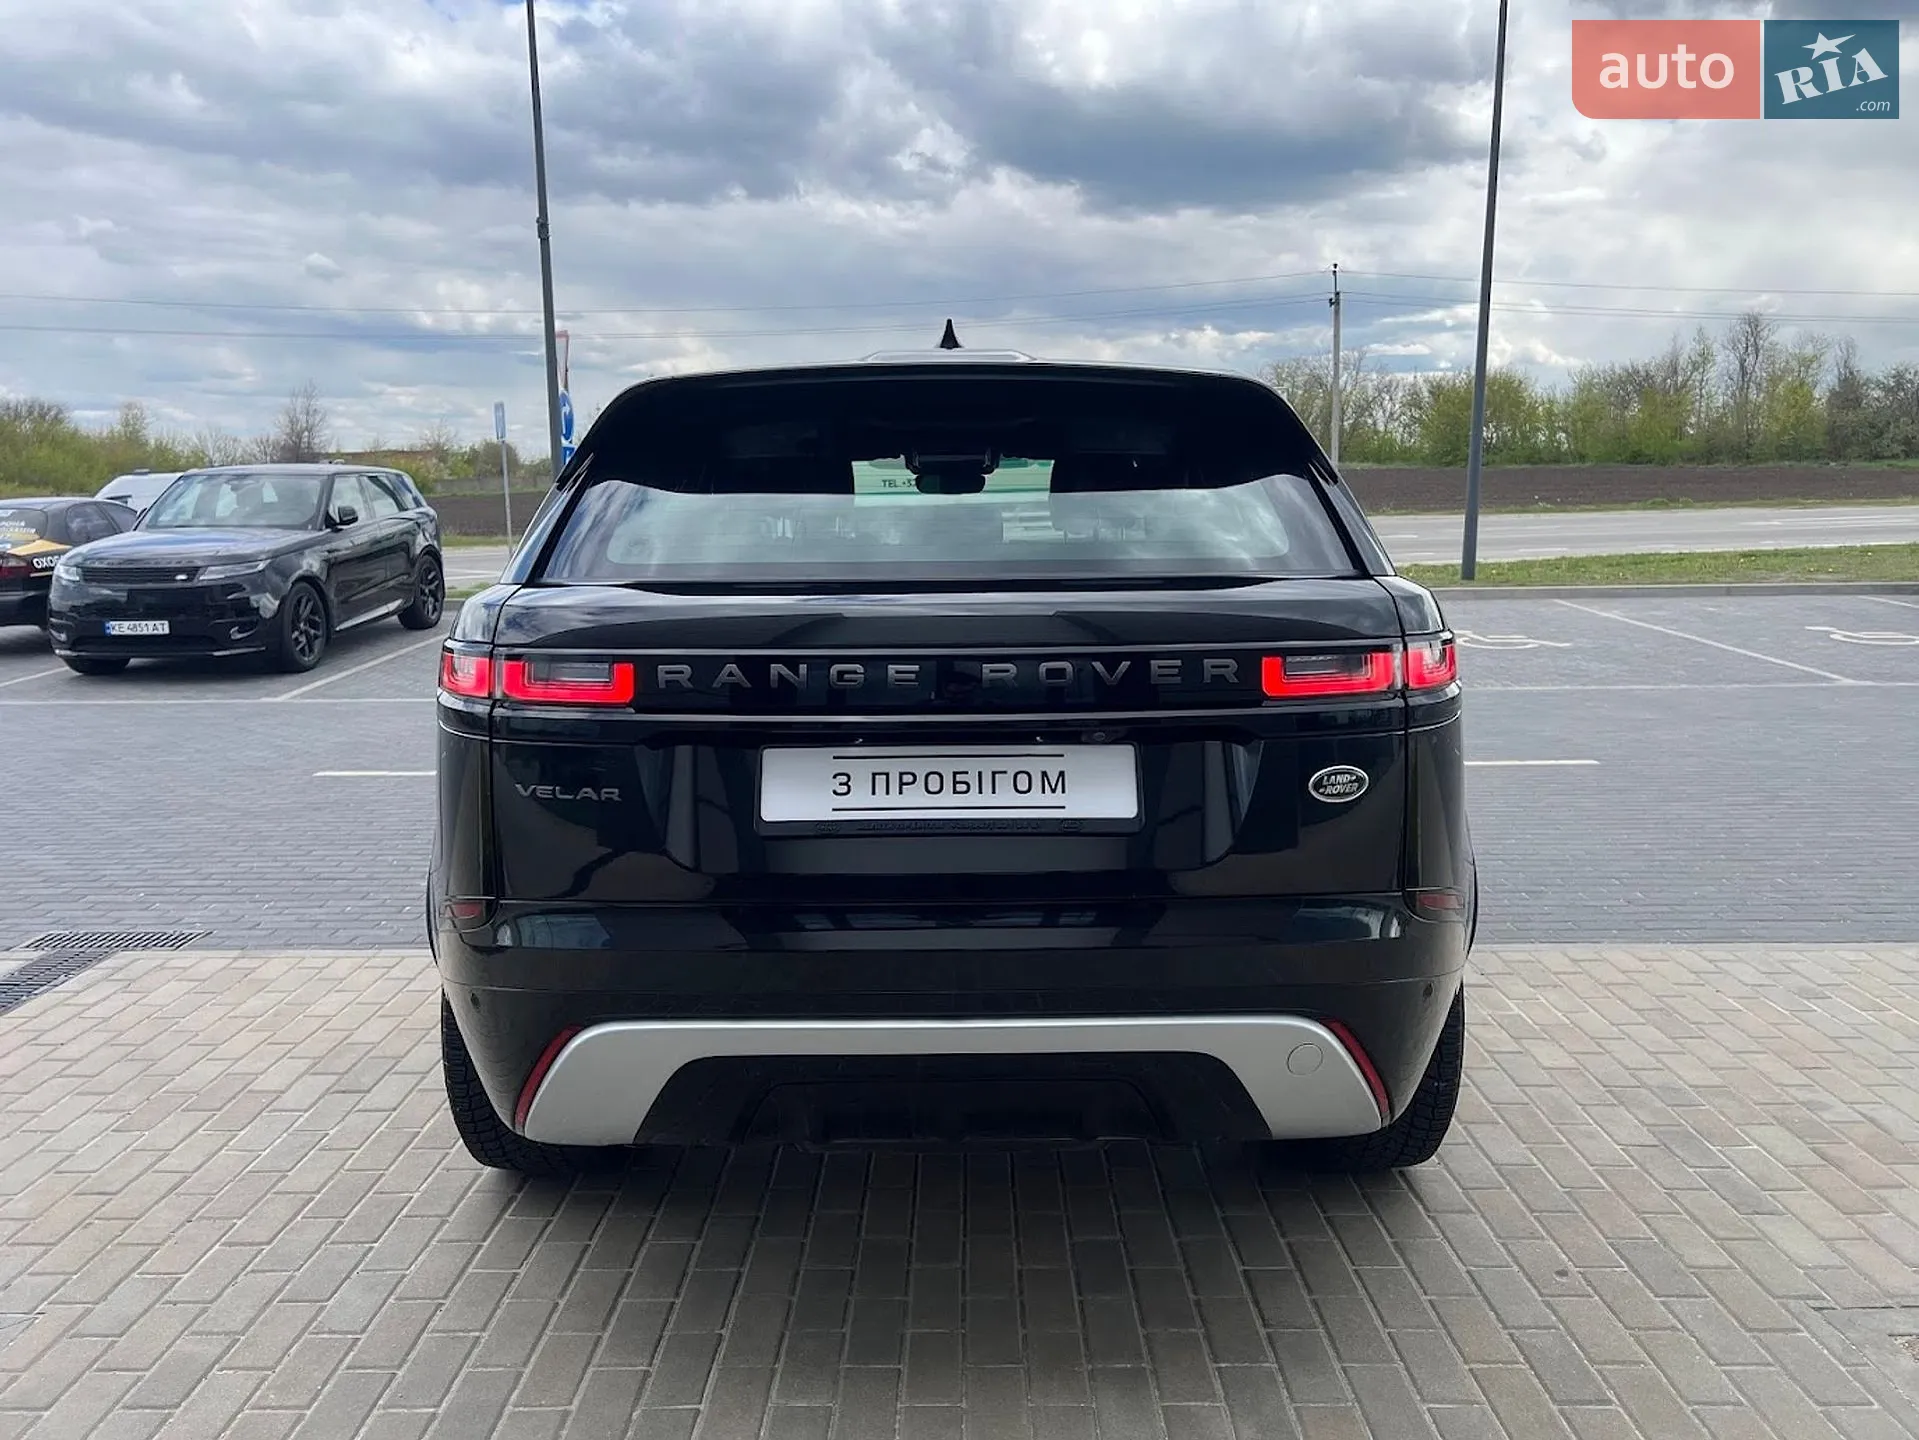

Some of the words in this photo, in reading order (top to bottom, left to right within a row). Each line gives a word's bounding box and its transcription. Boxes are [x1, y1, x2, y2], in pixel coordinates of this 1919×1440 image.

[152, 622, 166, 632] AT
[656, 661, 922, 689] RANGE
[984, 657, 1242, 687] ROVER
[832, 773, 852, 797] З
[871, 770, 1067, 796] ПРОБІГОМ
[1322, 773, 1351, 785] LAND
[514, 783, 622, 802] VELAR
[1324, 782, 1358, 795] ROVER
